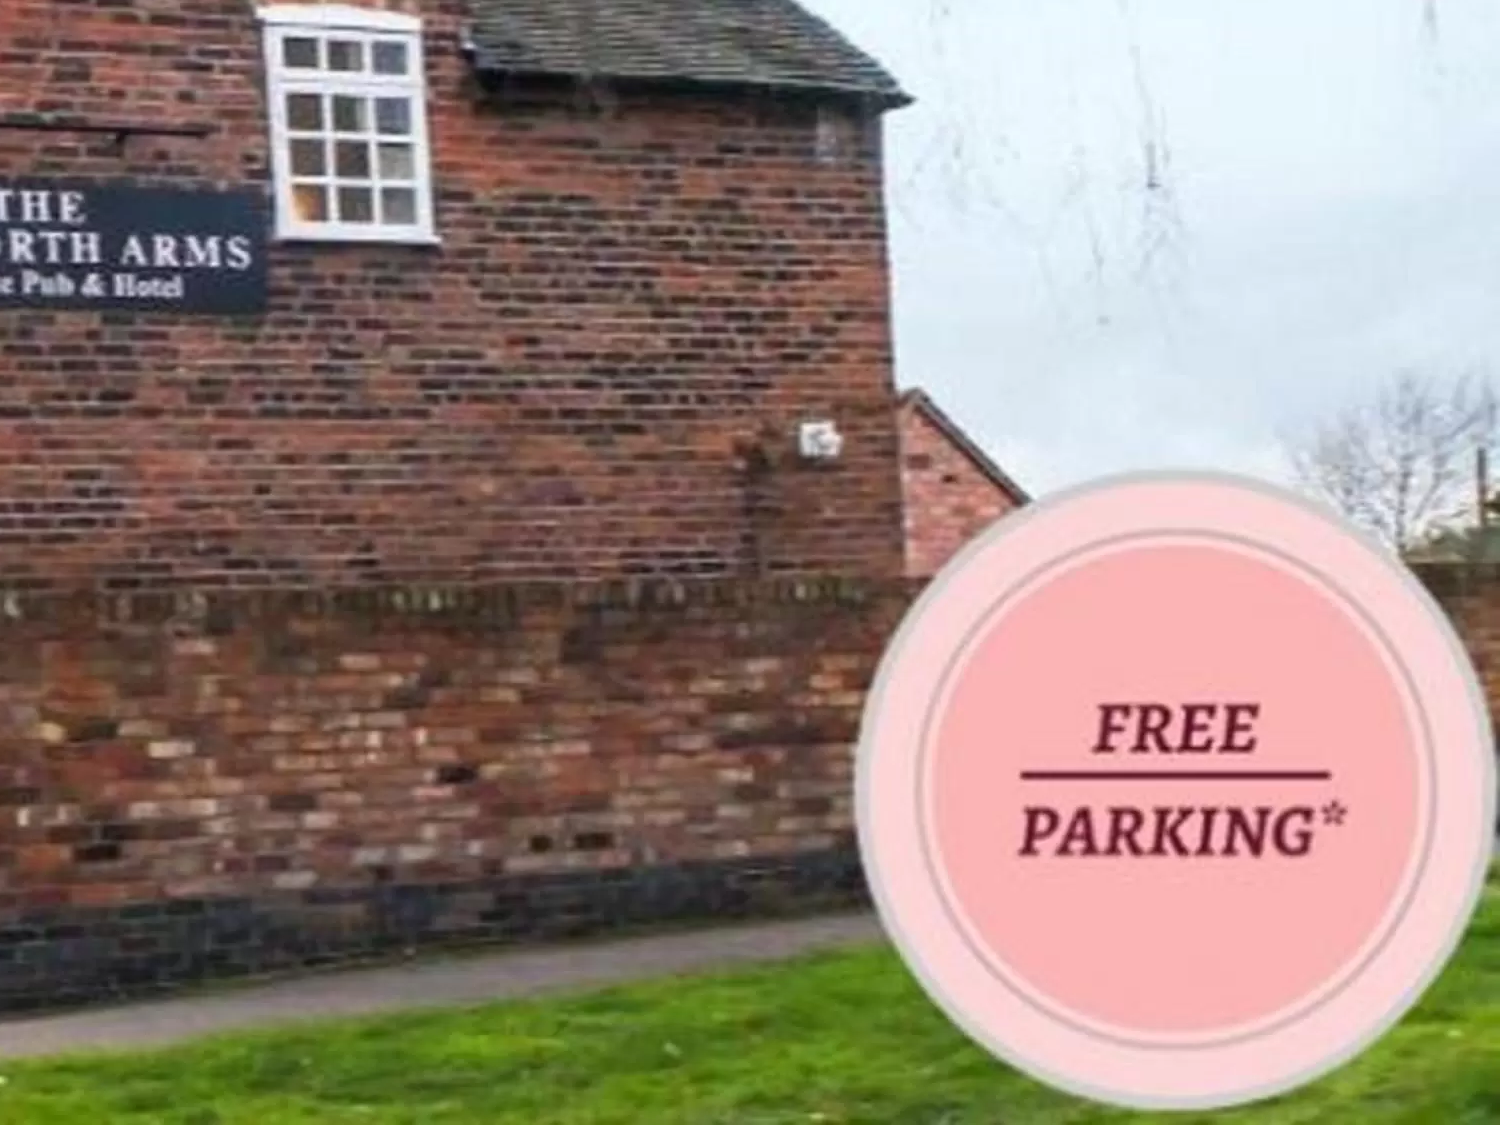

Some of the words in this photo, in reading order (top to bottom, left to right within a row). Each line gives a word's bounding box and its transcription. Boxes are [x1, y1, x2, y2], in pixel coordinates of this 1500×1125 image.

[120, 234, 252, 271] ARMS
[21, 271, 75, 296] Pub
[80, 275, 104, 297] &
[113, 275, 184, 299] Hotel
